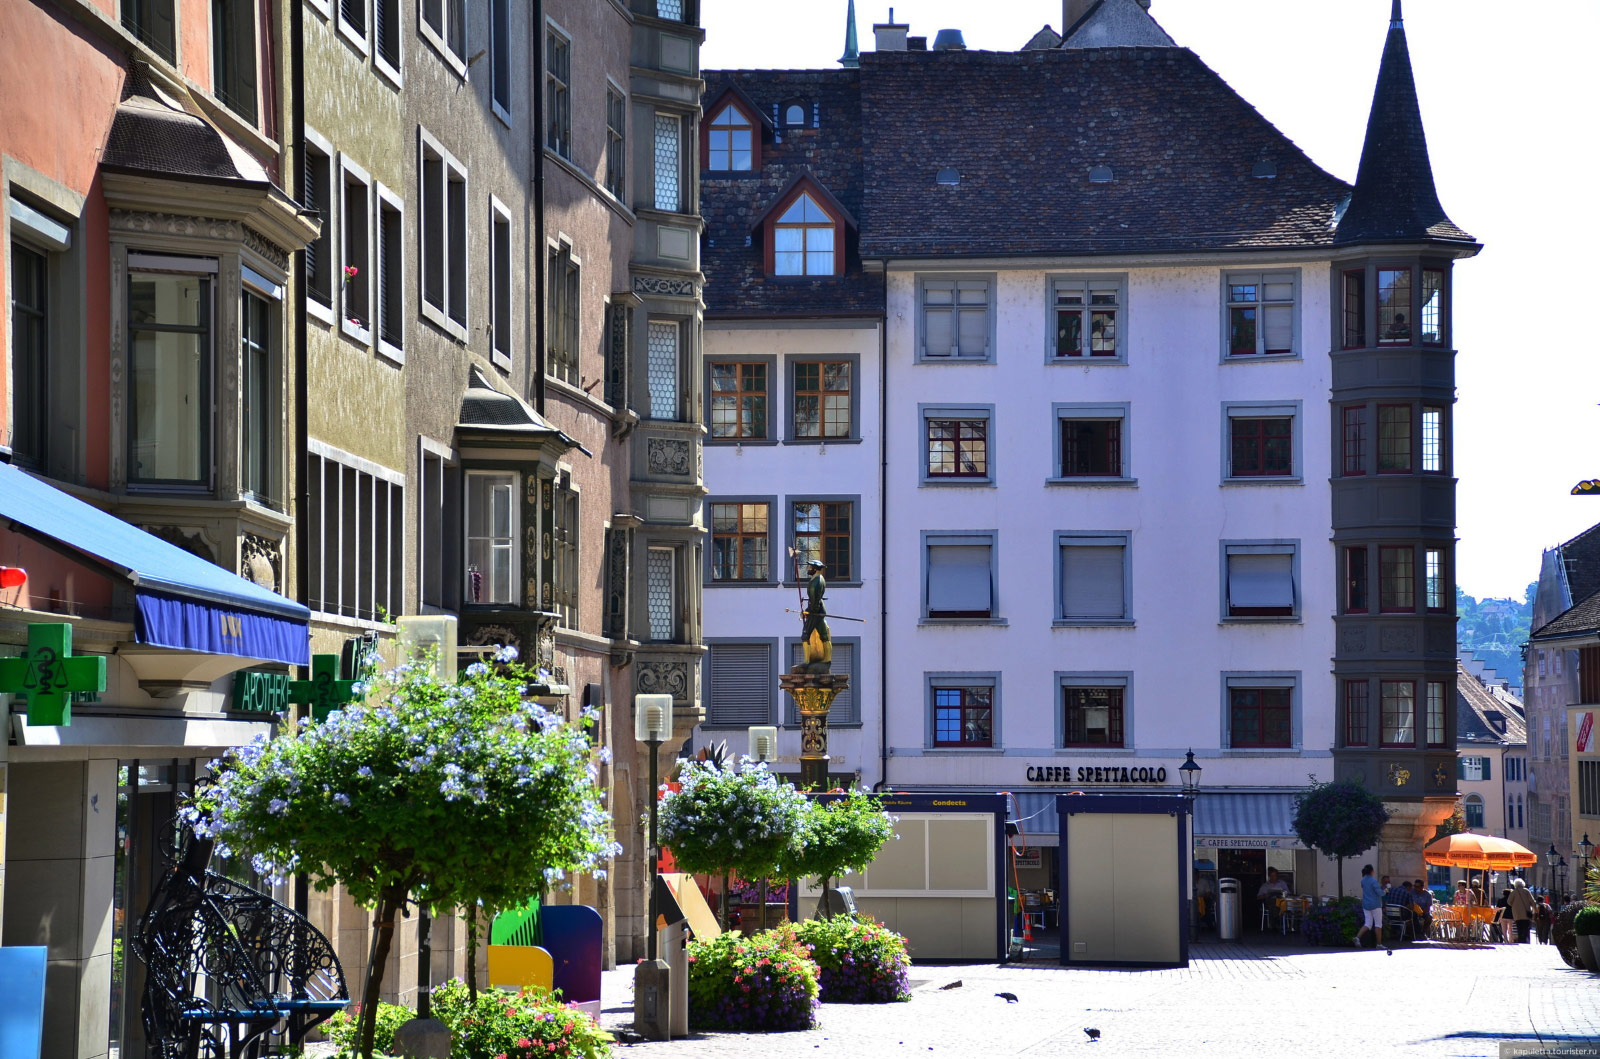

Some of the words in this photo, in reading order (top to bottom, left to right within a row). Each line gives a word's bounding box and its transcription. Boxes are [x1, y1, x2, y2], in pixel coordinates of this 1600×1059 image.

[1026, 766, 1071, 782] CAFFE
[1077, 766, 1167, 783] SPETTACOLO
[1208, 839, 1229, 847] CAFFE
[1230, 839, 1268, 847] SPETTACOLO
